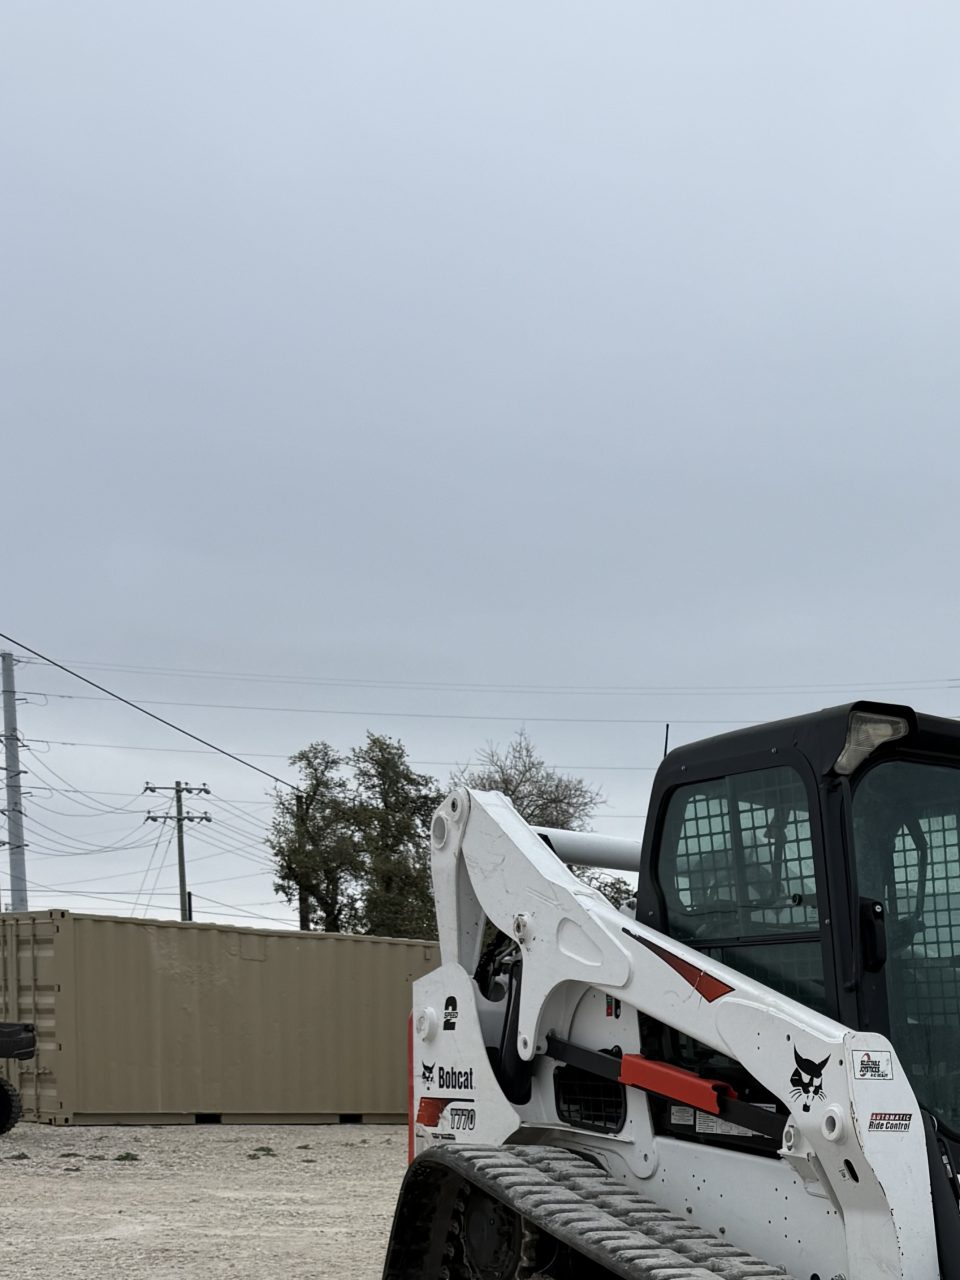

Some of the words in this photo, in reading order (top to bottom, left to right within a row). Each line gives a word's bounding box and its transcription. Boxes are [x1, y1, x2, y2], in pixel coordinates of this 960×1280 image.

[443, 996, 457, 1030] 2
[444, 1011, 458, 1019] SPEED
[438, 1066, 473, 1090] Bobcat
[450, 1108, 476, 1131] T770
[868, 1121, 885, 1130] Ride
[885, 1121, 911, 1130] Control
